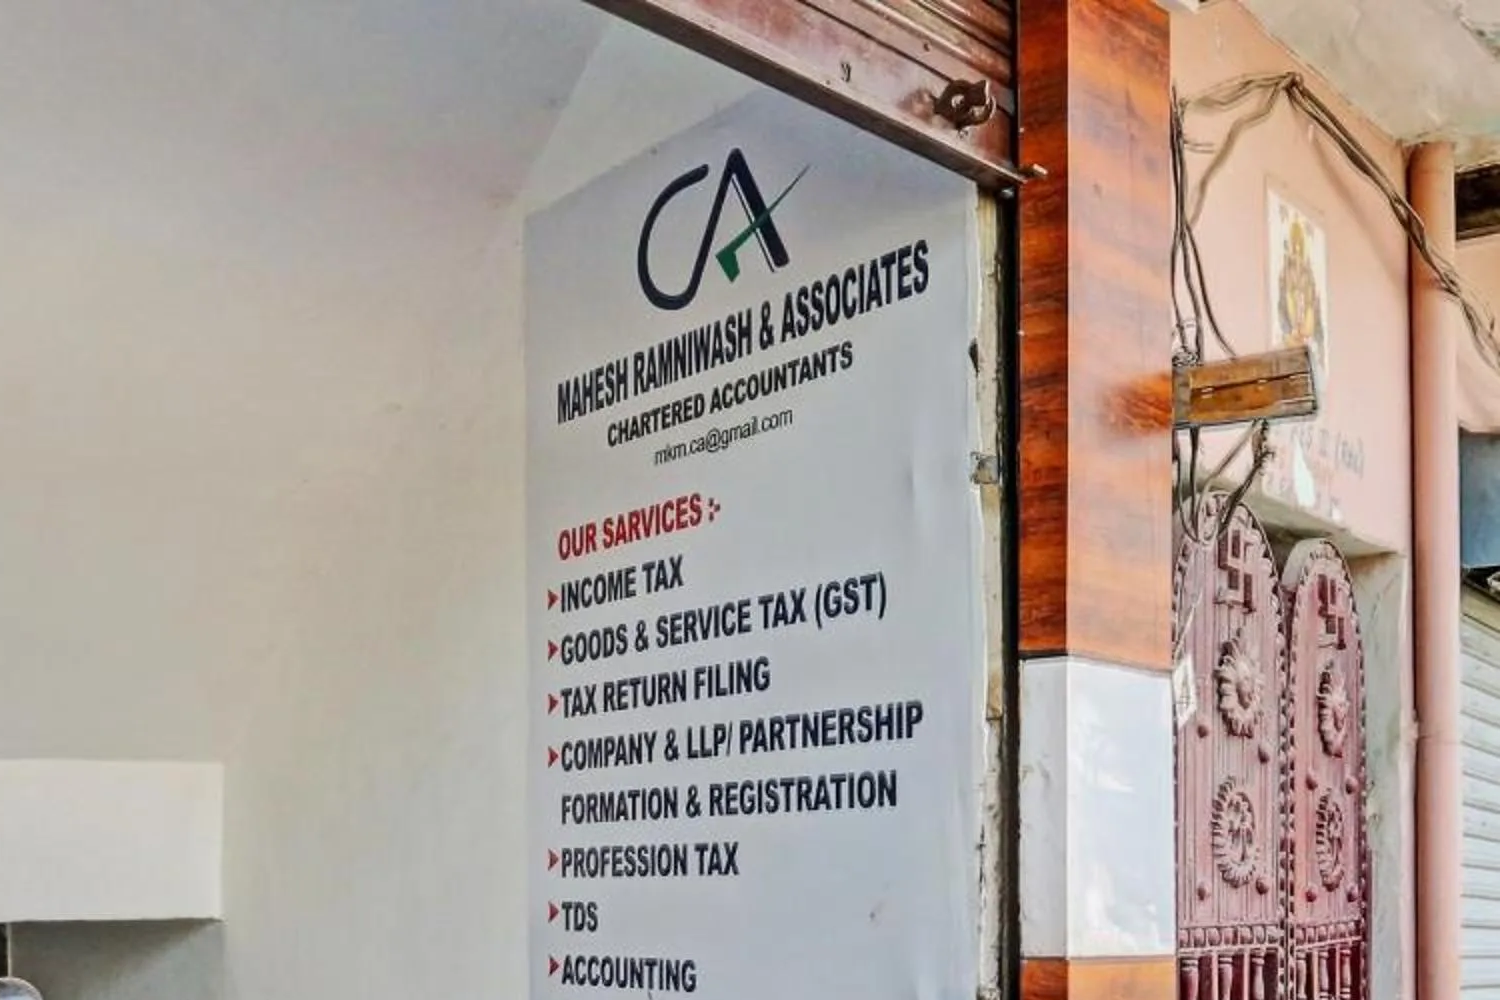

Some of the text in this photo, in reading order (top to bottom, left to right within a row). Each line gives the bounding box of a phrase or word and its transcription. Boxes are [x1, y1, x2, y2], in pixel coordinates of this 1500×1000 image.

[558, 240, 929, 424] MAHESH RAMNIWASH & ASSOCIATES
[607, 341, 853, 447] CHARTERED ACCOUNTANTS
[654, 409, 793, 465] mkm.ca@gmail.com
[558, 525, 597, 561] OUR
[603, 493, 702, 550] SARVICES
[561, 555, 684, 613] INCOME TAX
[561, 572, 887, 666] GOODS & SERVICE TAX (GST)
[561, 656, 771, 719] TAX RETURN FILING
[561, 730, 657, 772] COMPANY
[664, 729, 679, 761] &
[739, 700, 924, 755] PARTNERSHIP
[562, 770, 898, 825] FORMATION & REGISTRATION
[562, 842, 739, 878] PROFESSION TAX
[562, 902, 598, 932] TDS
[562, 956, 697, 993] ACCOUNTING
